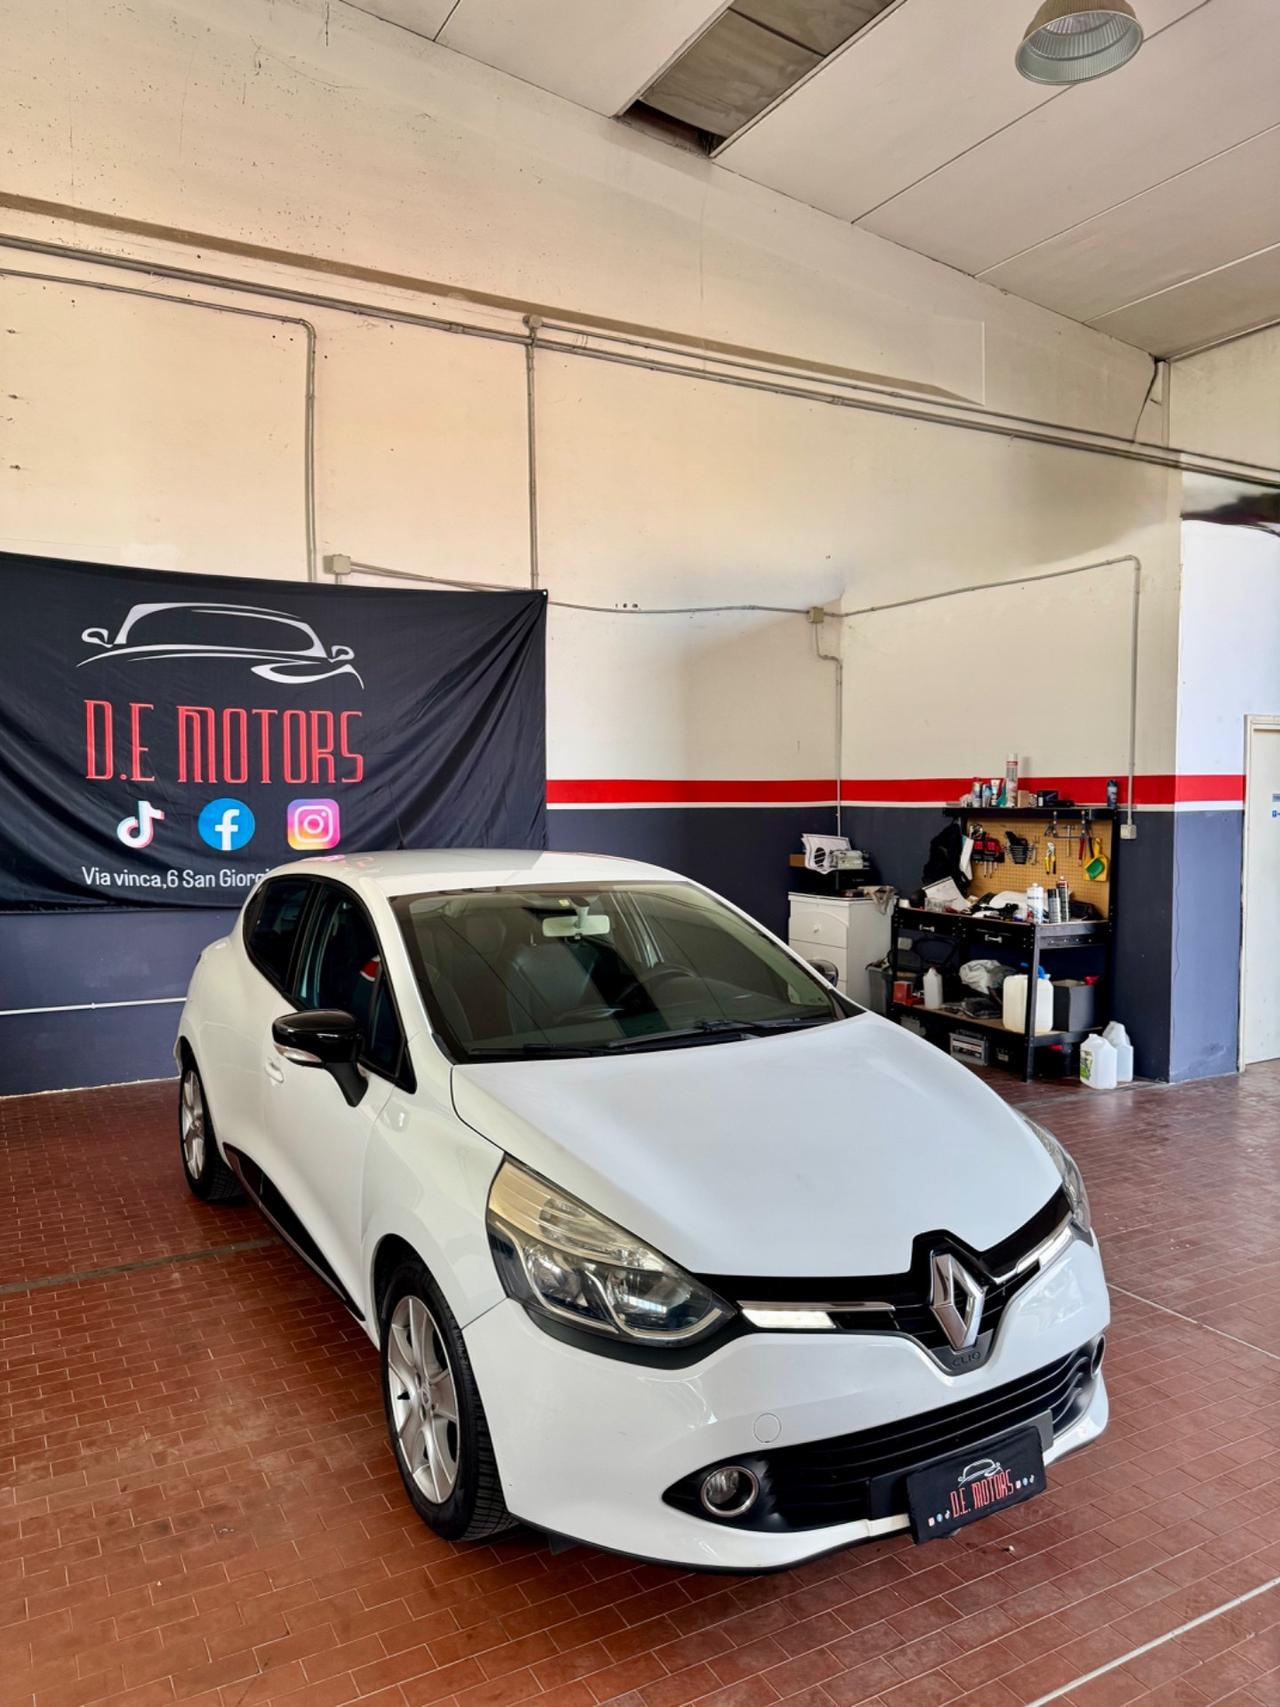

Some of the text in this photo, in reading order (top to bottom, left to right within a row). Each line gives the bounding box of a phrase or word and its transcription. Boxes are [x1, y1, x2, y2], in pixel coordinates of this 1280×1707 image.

[83, 700, 364, 784] D.E MOTORS
[82, 866, 111, 886] Via
[182, 869, 216, 888] San
[971, 1469, 1014, 1509] MOTORS
